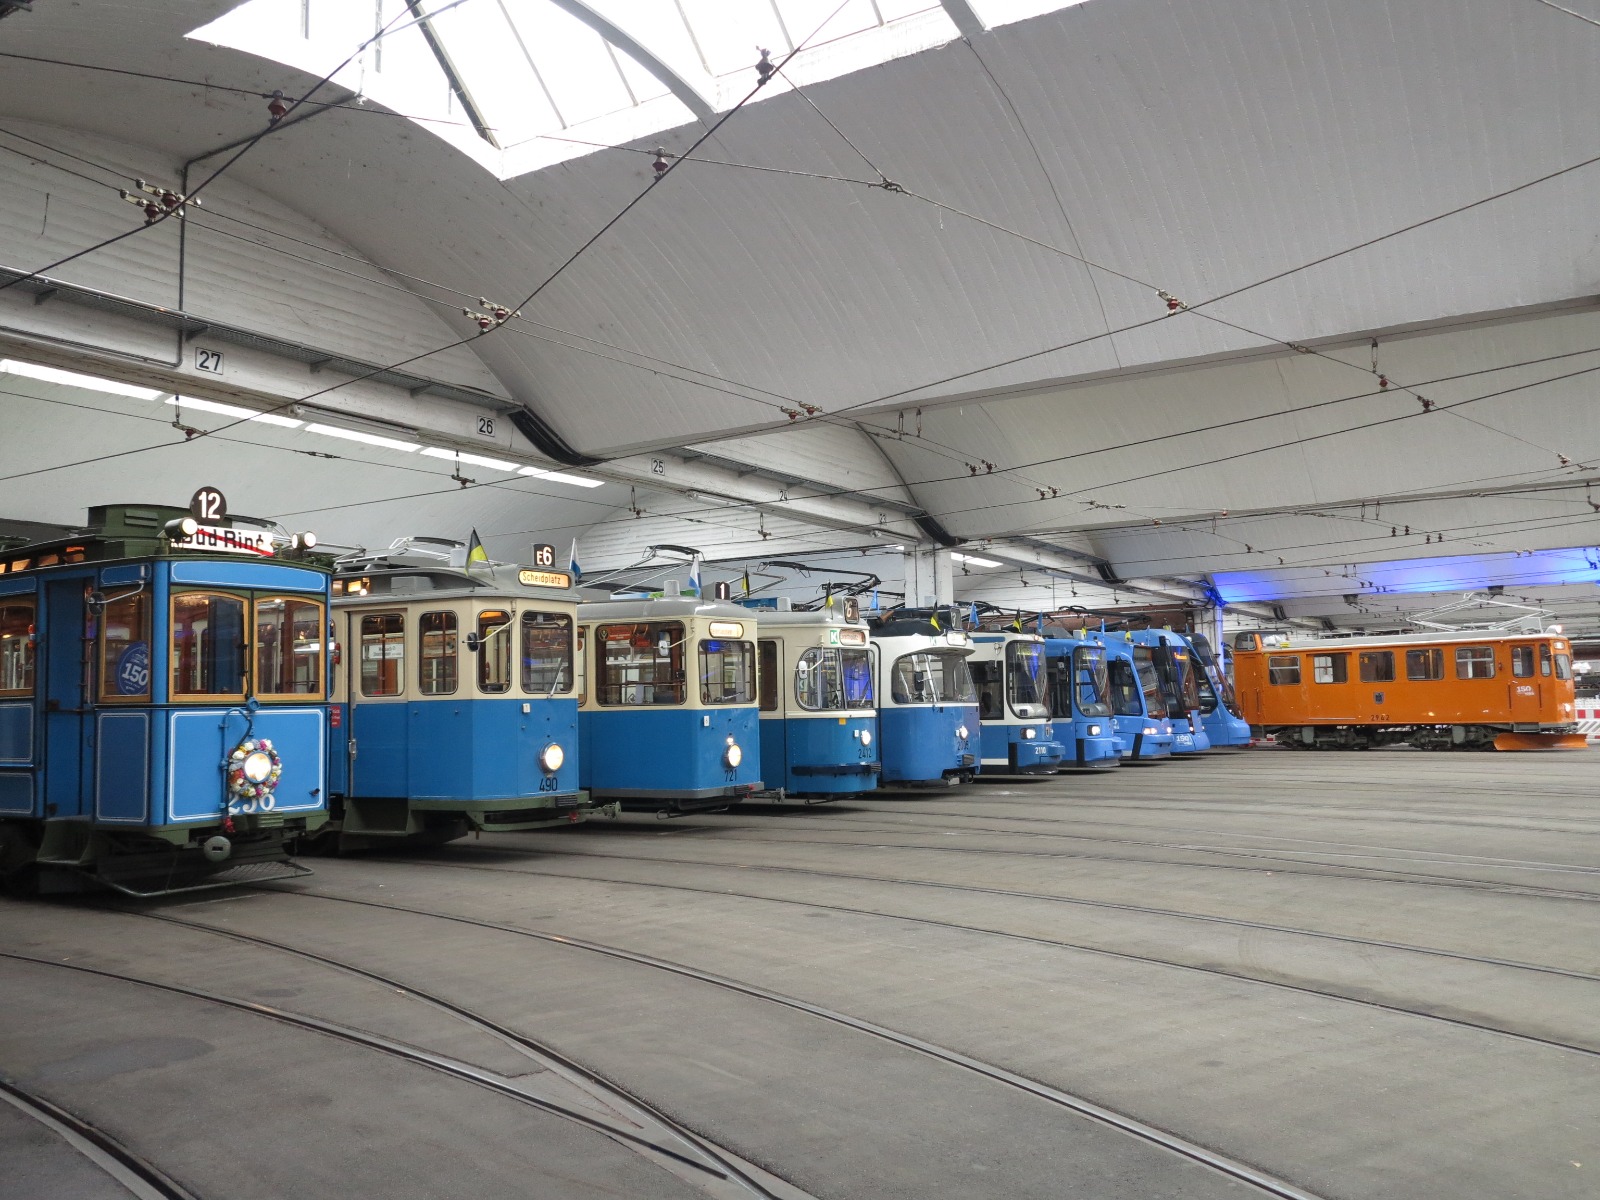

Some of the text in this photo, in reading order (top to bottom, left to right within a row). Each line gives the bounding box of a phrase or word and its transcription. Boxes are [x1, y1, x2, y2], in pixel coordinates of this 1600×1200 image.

[199, 350, 221, 371] 27
[479, 417, 493, 434] 26
[653, 459, 663, 474] 25
[779, 490, 788, 502] 24
[199, 491, 221, 519] 12
[536, 546, 553, 566] E6
[522, 572, 561, 585] Scheidplatz
[720, 583, 725, 600] 1
[830, 631, 838, 643] K
[121, 662, 149, 686] 150
[1516, 685, 1531, 693] 150
[858, 747, 872, 759] 2412
[1034, 746, 1047, 755] 2110
[724, 769, 737, 782] 721
[539, 777, 558, 792] 490
